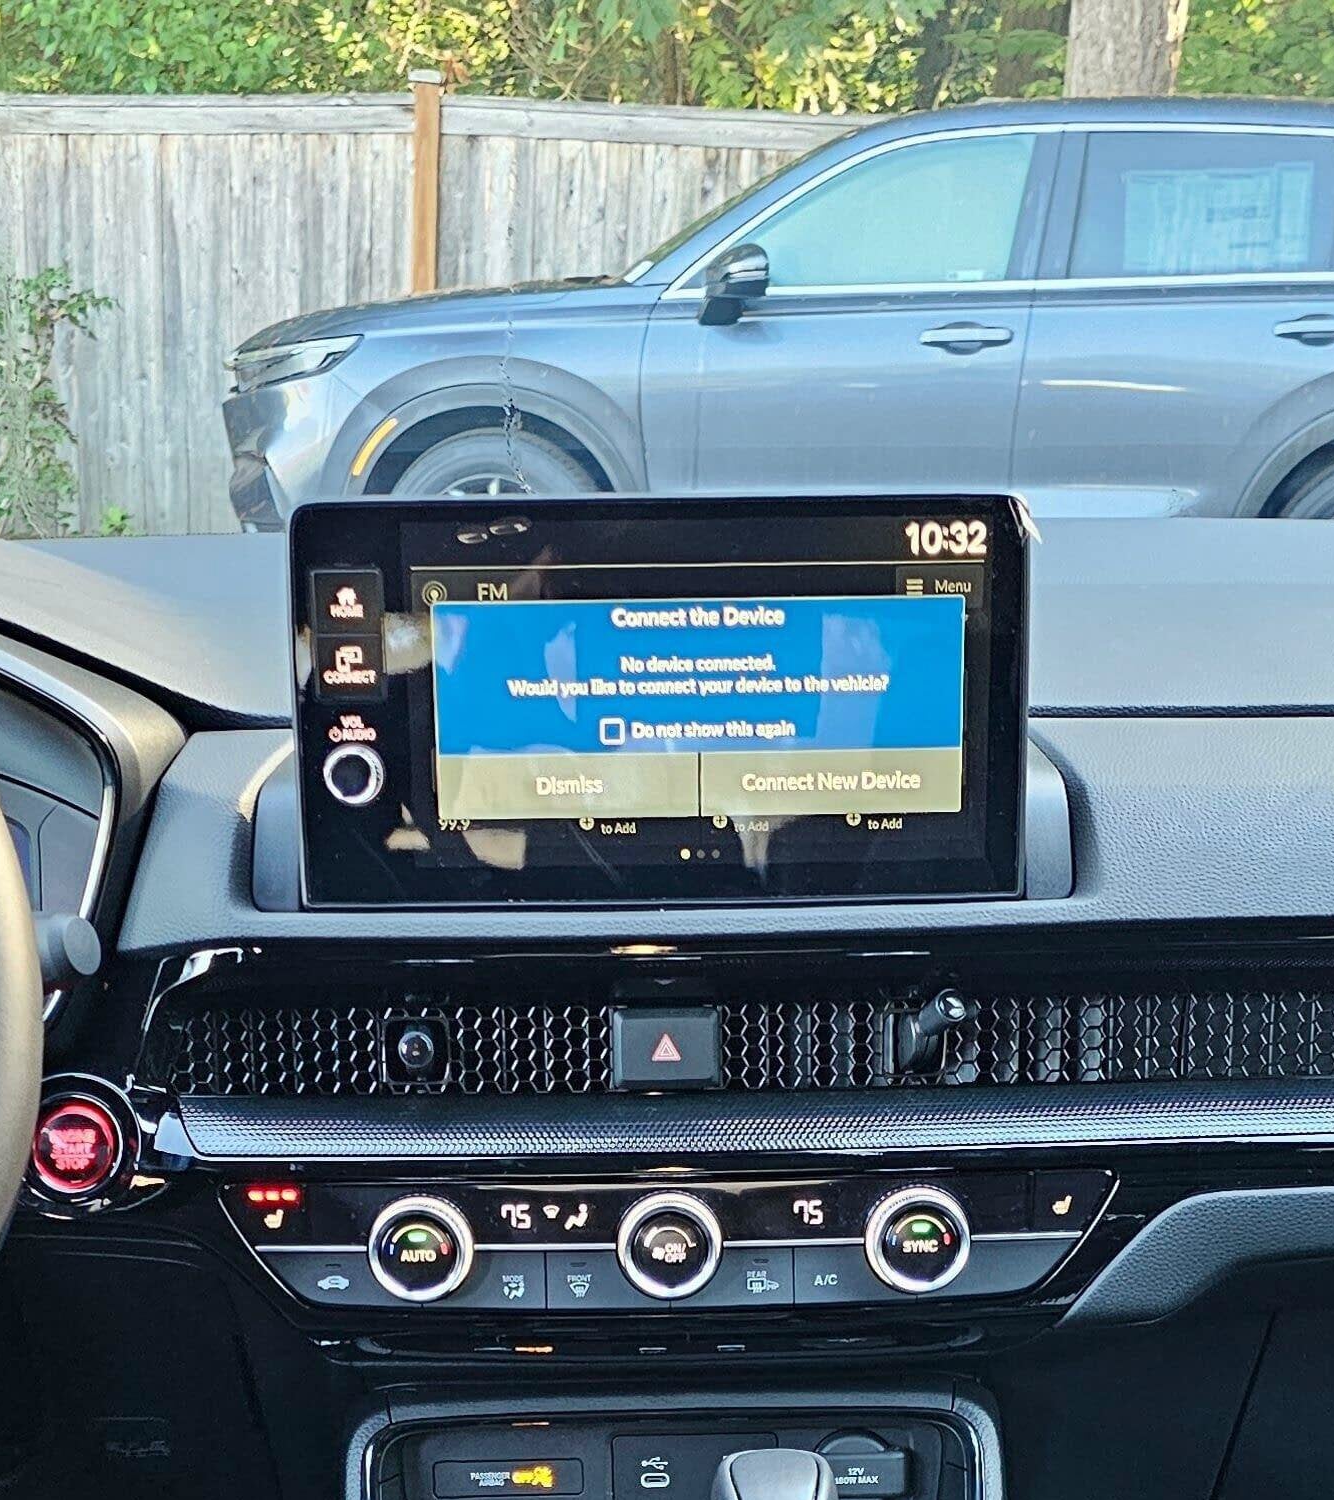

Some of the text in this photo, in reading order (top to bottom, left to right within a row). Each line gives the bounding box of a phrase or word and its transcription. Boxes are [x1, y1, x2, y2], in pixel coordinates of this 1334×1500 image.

[905, 520, 987, 555] 10:32
[477, 583, 508, 601] FM
[934, 579, 972, 594] Menu
[330, 604, 364, 618] HOME
[611, 606, 785, 628] Connect the Device
[620, 654, 776, 673] No device connected.
[323, 669, 376, 685] CONNECT
[506, 674, 889, 699] Would you like to connect your device to the vehicle?
[340, 715, 364, 728] VOL
[343, 728, 376, 741] AUDIO
[631, 720, 795, 739] Do not show this again
[536, 774, 603, 796] Dismiss
[741, 770, 921, 792] Connect New Device
[600, 822, 636, 835] to Add
[734, 820, 768, 833] to Add
[867, 818, 902, 831] to Add
[500, 1203, 532, 1229] 75
[793, 1199, 824, 1225] 75
[902, 1240, 938, 1254] SYNC
[400, 1249, 436, 1263] AUTO
[664, 1252, 686, 1263] OFF
[502, 1275, 524, 1284] MODE
[567, 1274, 592, 1283] FRONT
[746, 1271, 767, 1279] REAR
[814, 1274, 838, 1286] A/C
[470, 1471, 510, 1480] PASSENGER
[858, 1475, 879, 1484] MAX
[478, 1479, 505, 1487] AIRBAG
